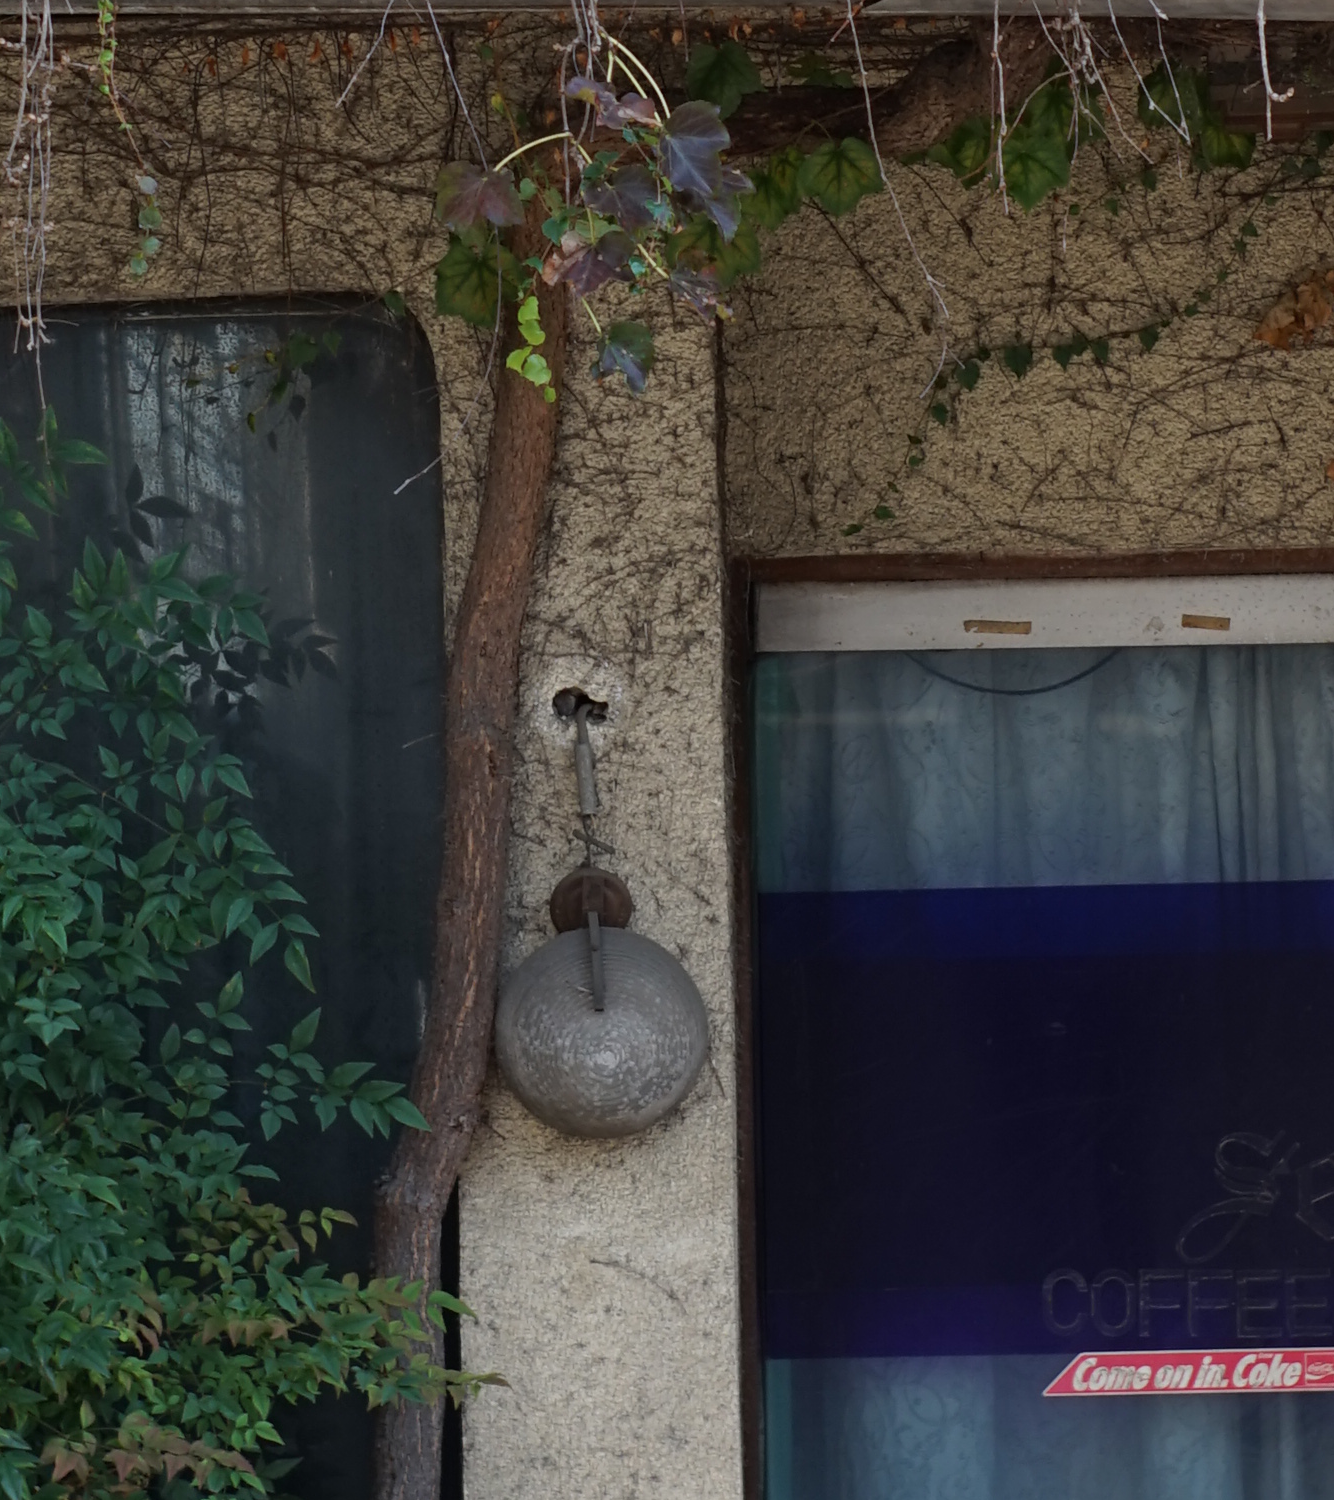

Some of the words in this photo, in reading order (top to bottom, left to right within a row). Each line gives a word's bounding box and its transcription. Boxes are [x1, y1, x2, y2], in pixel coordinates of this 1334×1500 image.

[1042, 1267, 1333, 1339] COFFEE
[1072, 1357, 1151, 1391] Come
[1154, 1363, 1194, 1389] on
[1193, 1356, 1229, 1388] in.
[1232, 1353, 1302, 1390] Coke
